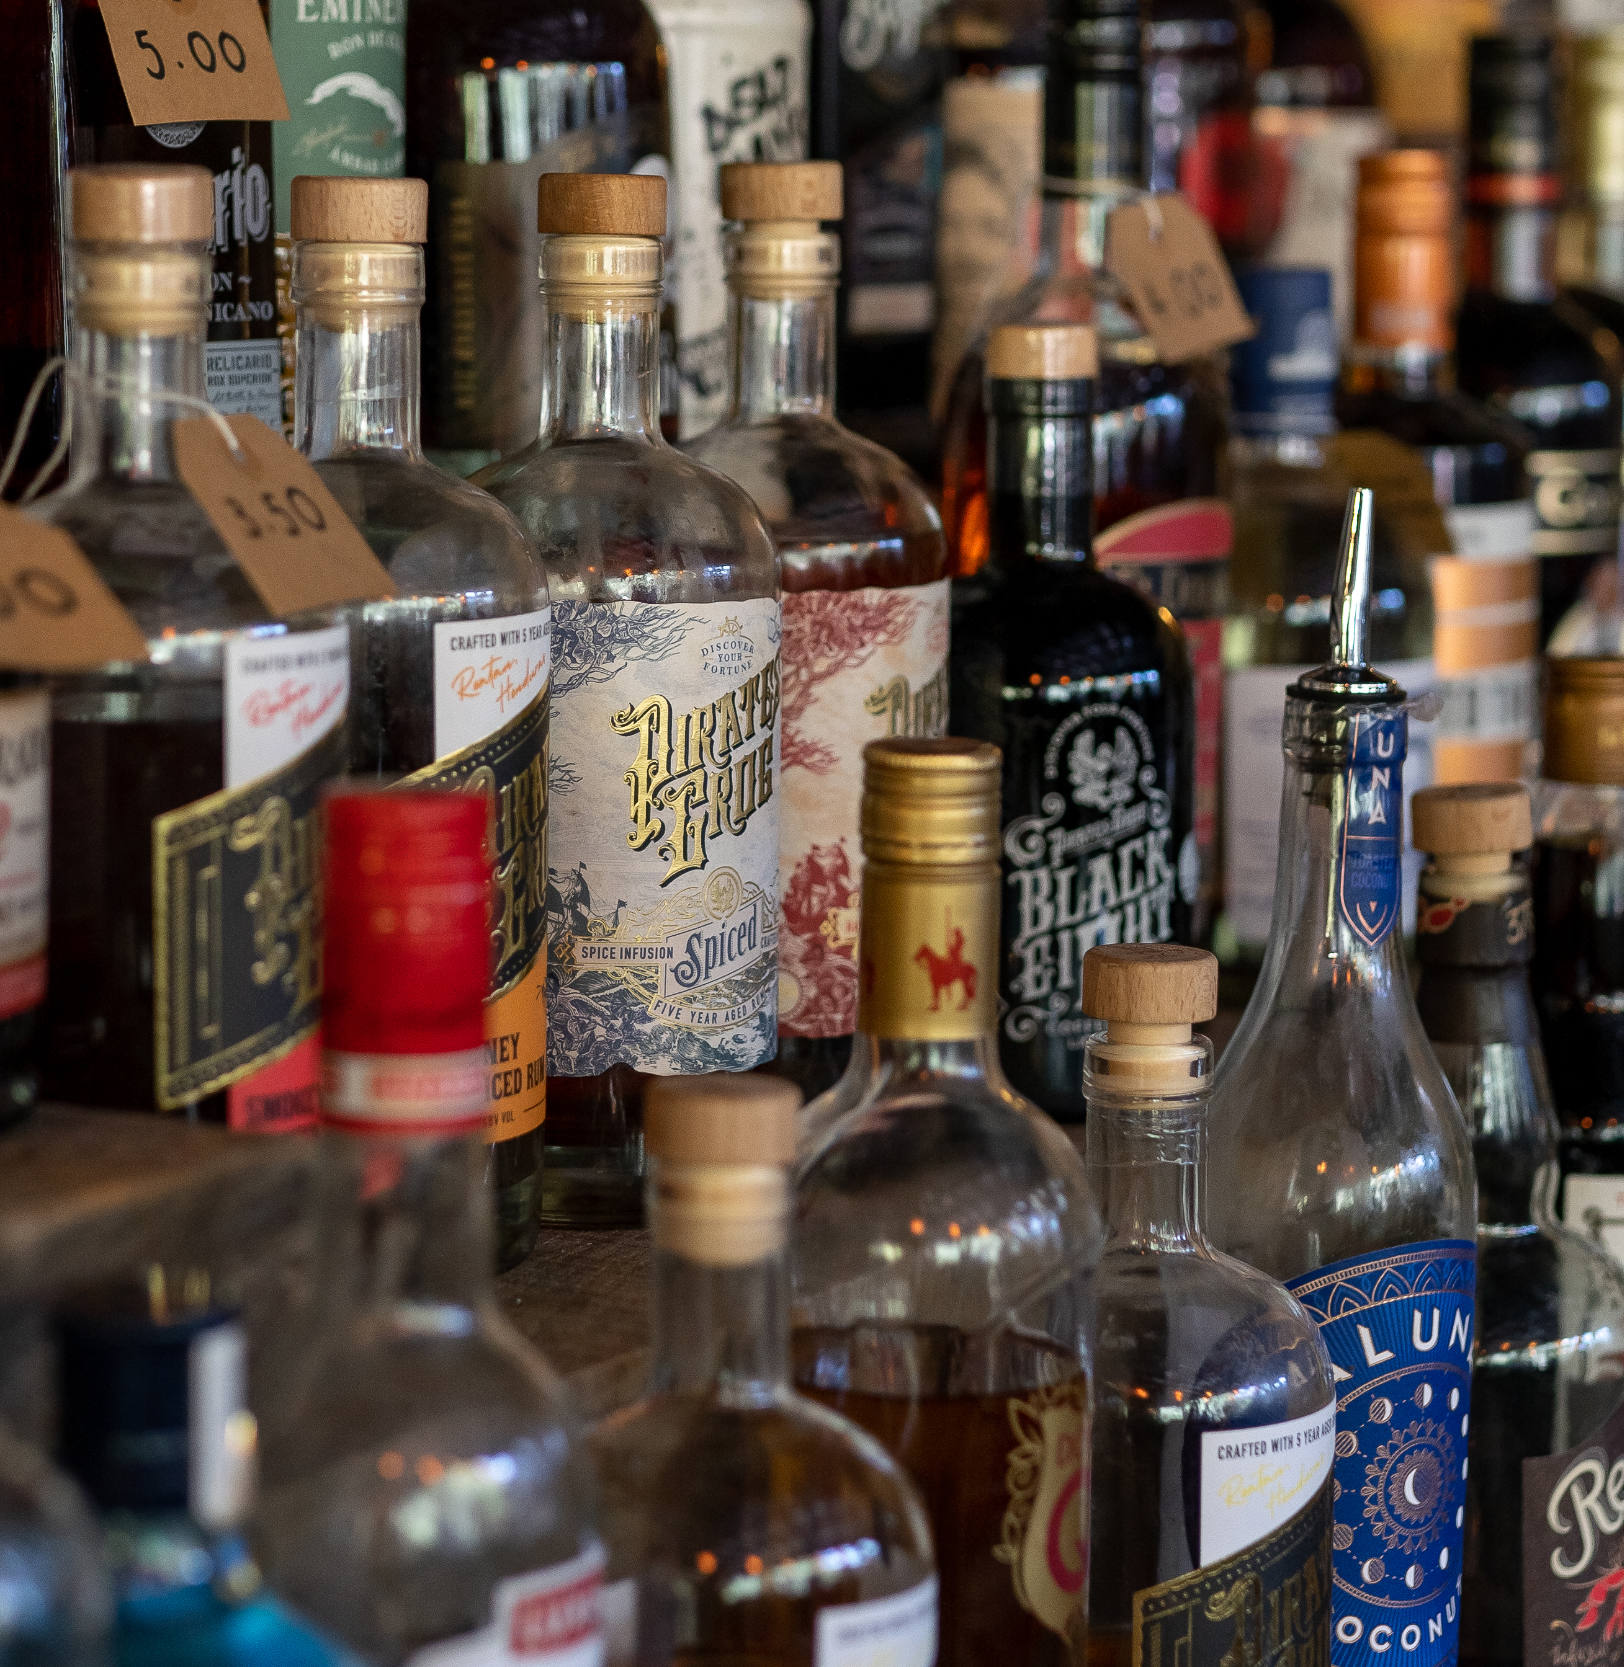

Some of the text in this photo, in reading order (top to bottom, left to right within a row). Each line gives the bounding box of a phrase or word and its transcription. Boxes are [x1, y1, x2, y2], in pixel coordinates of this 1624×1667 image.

[135, 30, 246, 80] 5.00
[449, 633, 498, 651] CRAFTED
[500, 629, 520, 646] WITH
[522, 627, 528, 642] 5
[529, 624, 542, 641] YEAR
[701, 640, 755, 657] DISCOVER
[704, 660, 753, 675] FORTUNE
[718, 652, 742, 662] YOUR
[657, 733, 773, 889] GROG
[1007, 827, 1174, 938] BLACK
[581, 946, 674, 960] SPICE INFUSION
[670, 902, 758, 989] Spiced
[654, 1000, 683, 1020] FIVE
[690, 1011, 718, 1025] YEAR
[724, 1004, 748, 1022] AGED
[1217, 1440, 1267, 1461] CRAFTED
[1270, 1435, 1294, 1453] WITH
[1296, 1432, 1302, 1447] 5
[1304, 1425, 1320, 1445] YEAR
[1331, 1573, 1462, 1653] OCONU
